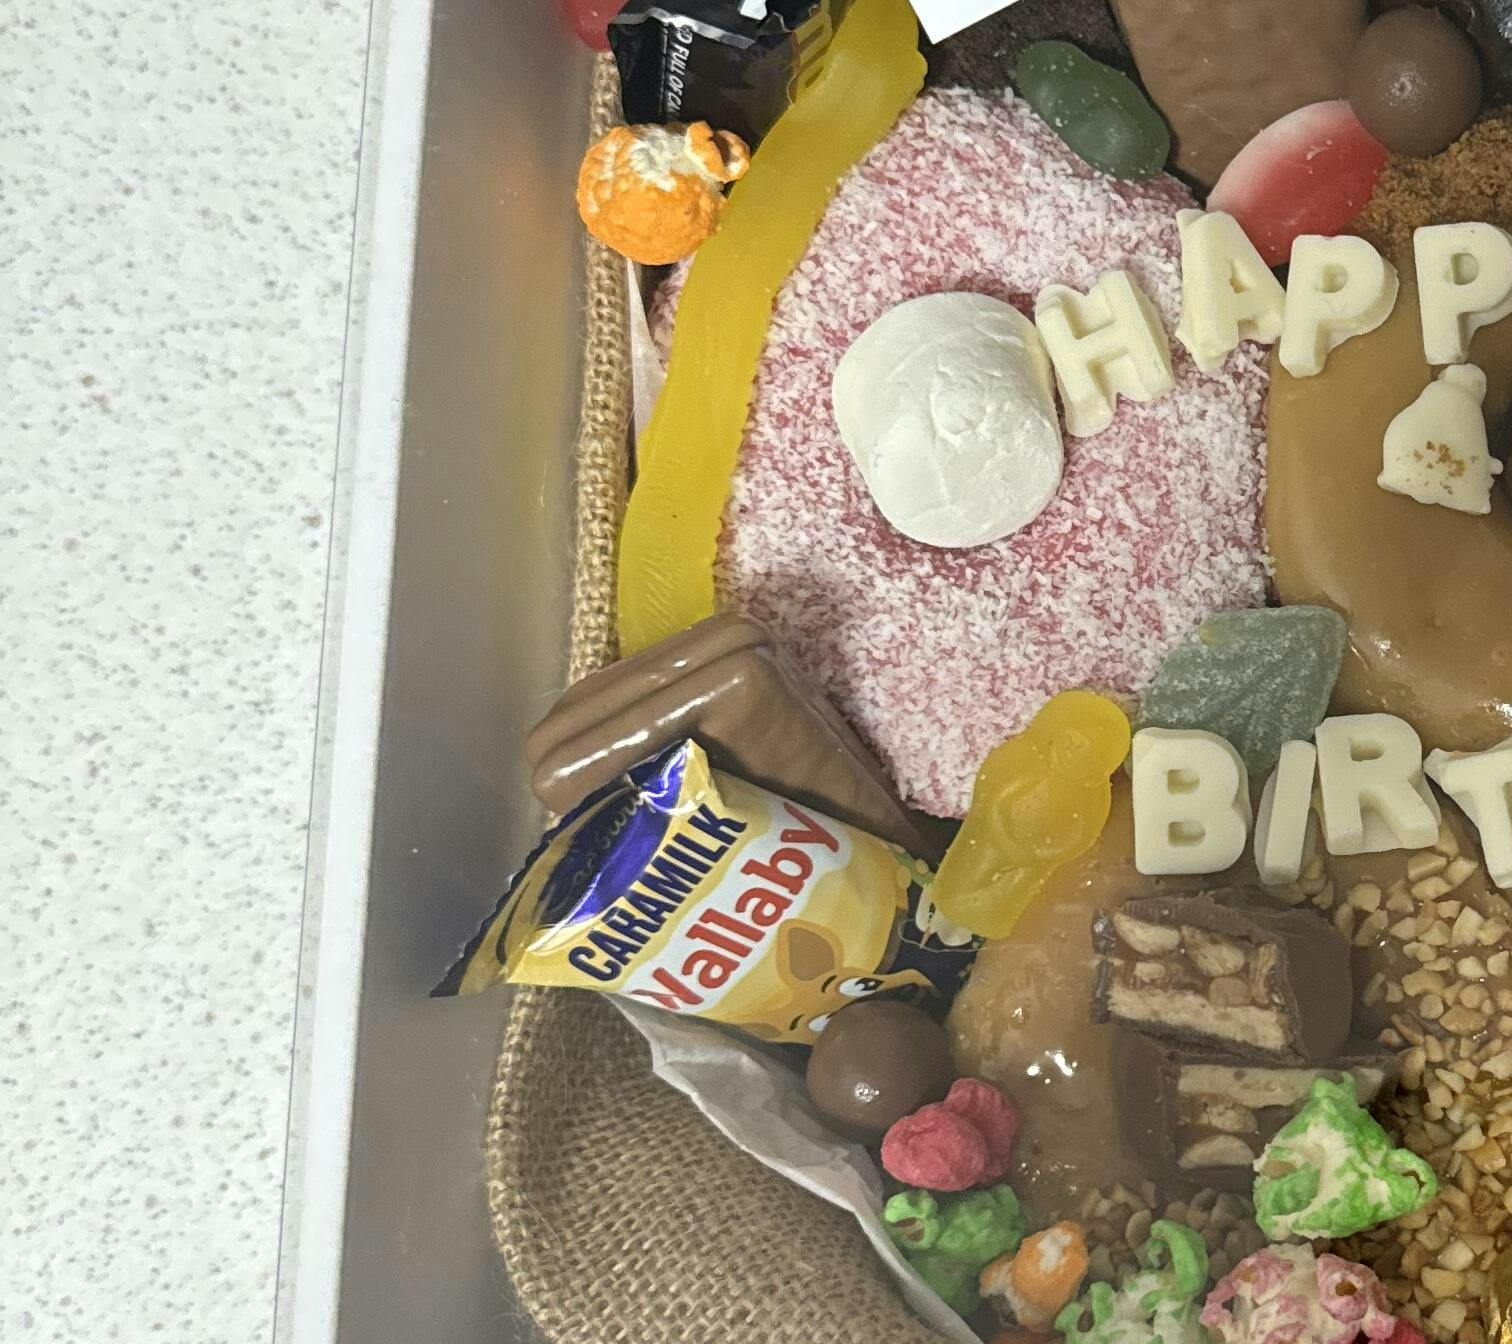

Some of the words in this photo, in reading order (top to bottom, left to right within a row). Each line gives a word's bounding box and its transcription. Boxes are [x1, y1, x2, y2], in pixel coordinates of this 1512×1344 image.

[669, 43, 689, 75] FULL
[668, 74, 685, 96] OF
[568, 803, 747, 982] CARAMILK
